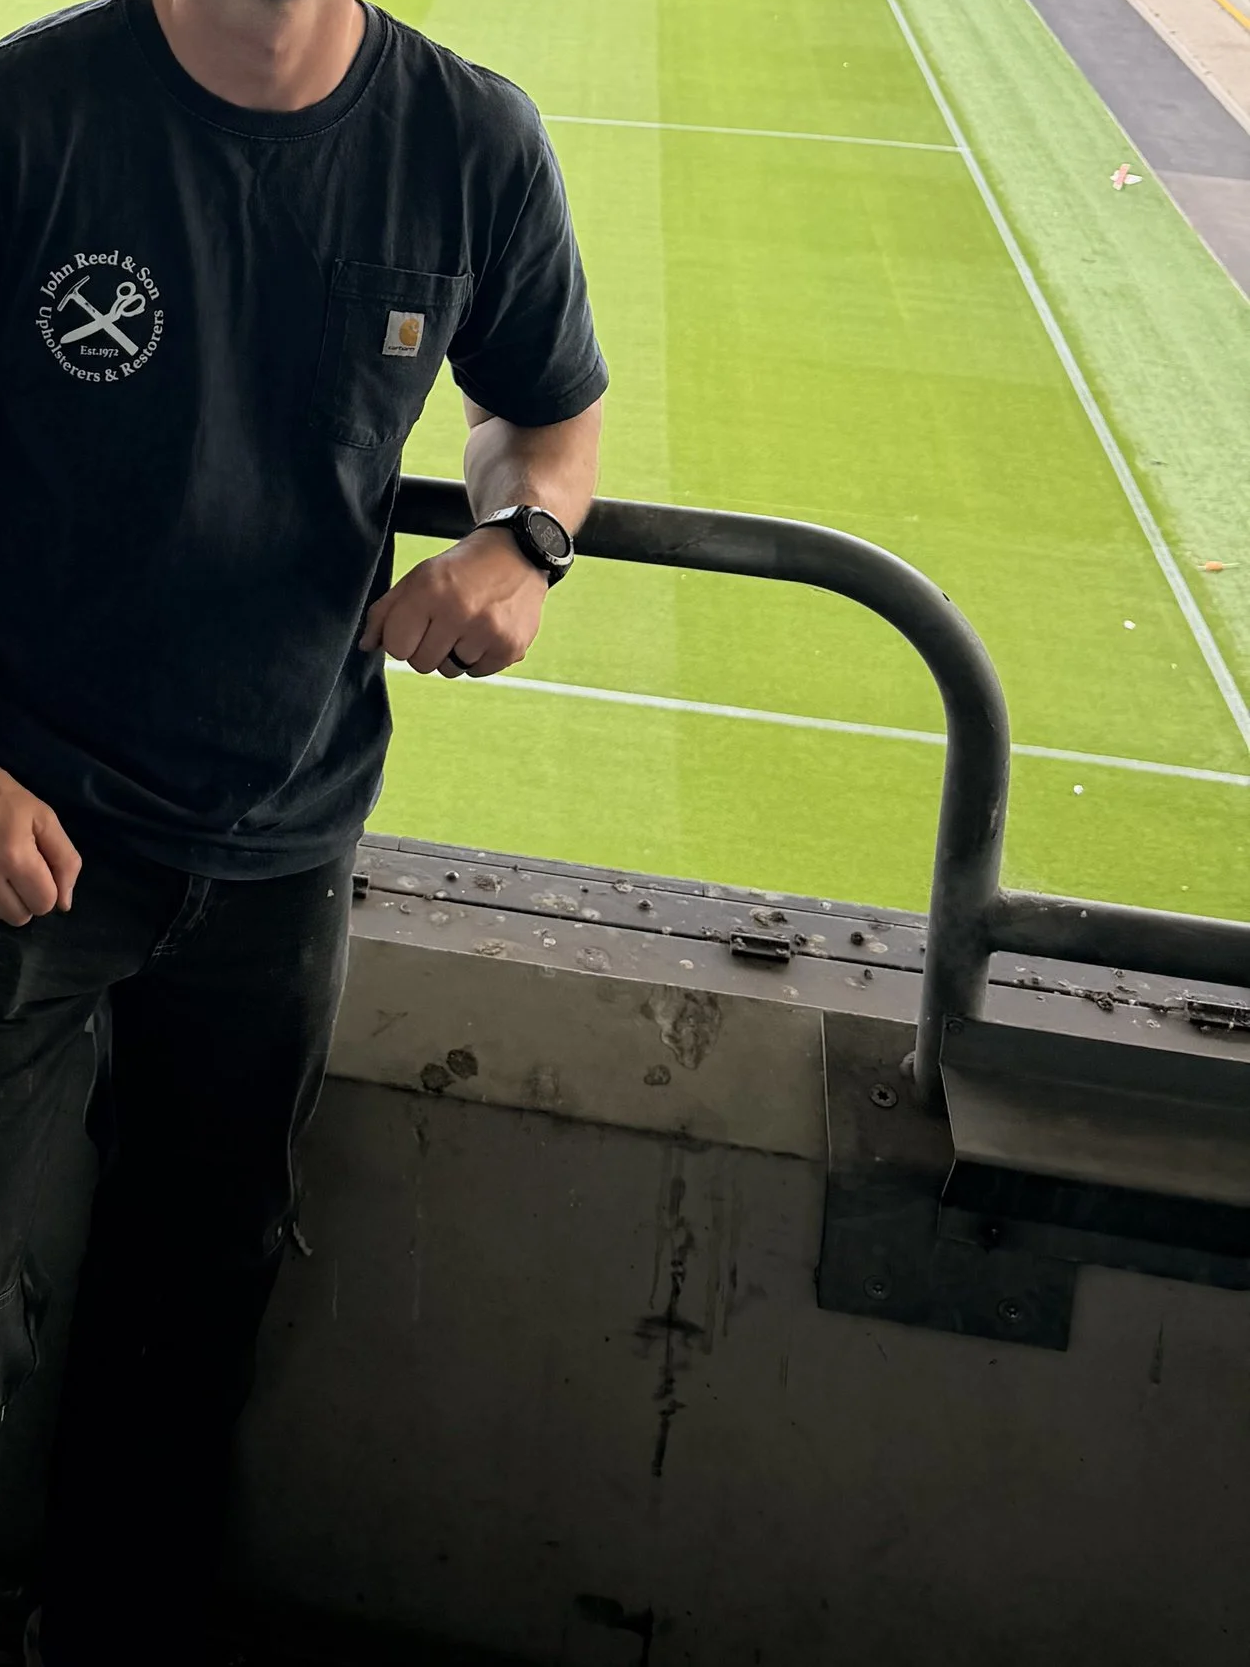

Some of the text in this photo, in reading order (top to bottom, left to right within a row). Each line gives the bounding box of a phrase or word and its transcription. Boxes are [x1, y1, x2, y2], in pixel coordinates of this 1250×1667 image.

[40, 250, 161, 301] John Reed & Son
[35, 306, 164, 383] Upholsterers & Restorers
[80, 345, 119, 358] Est.1972
